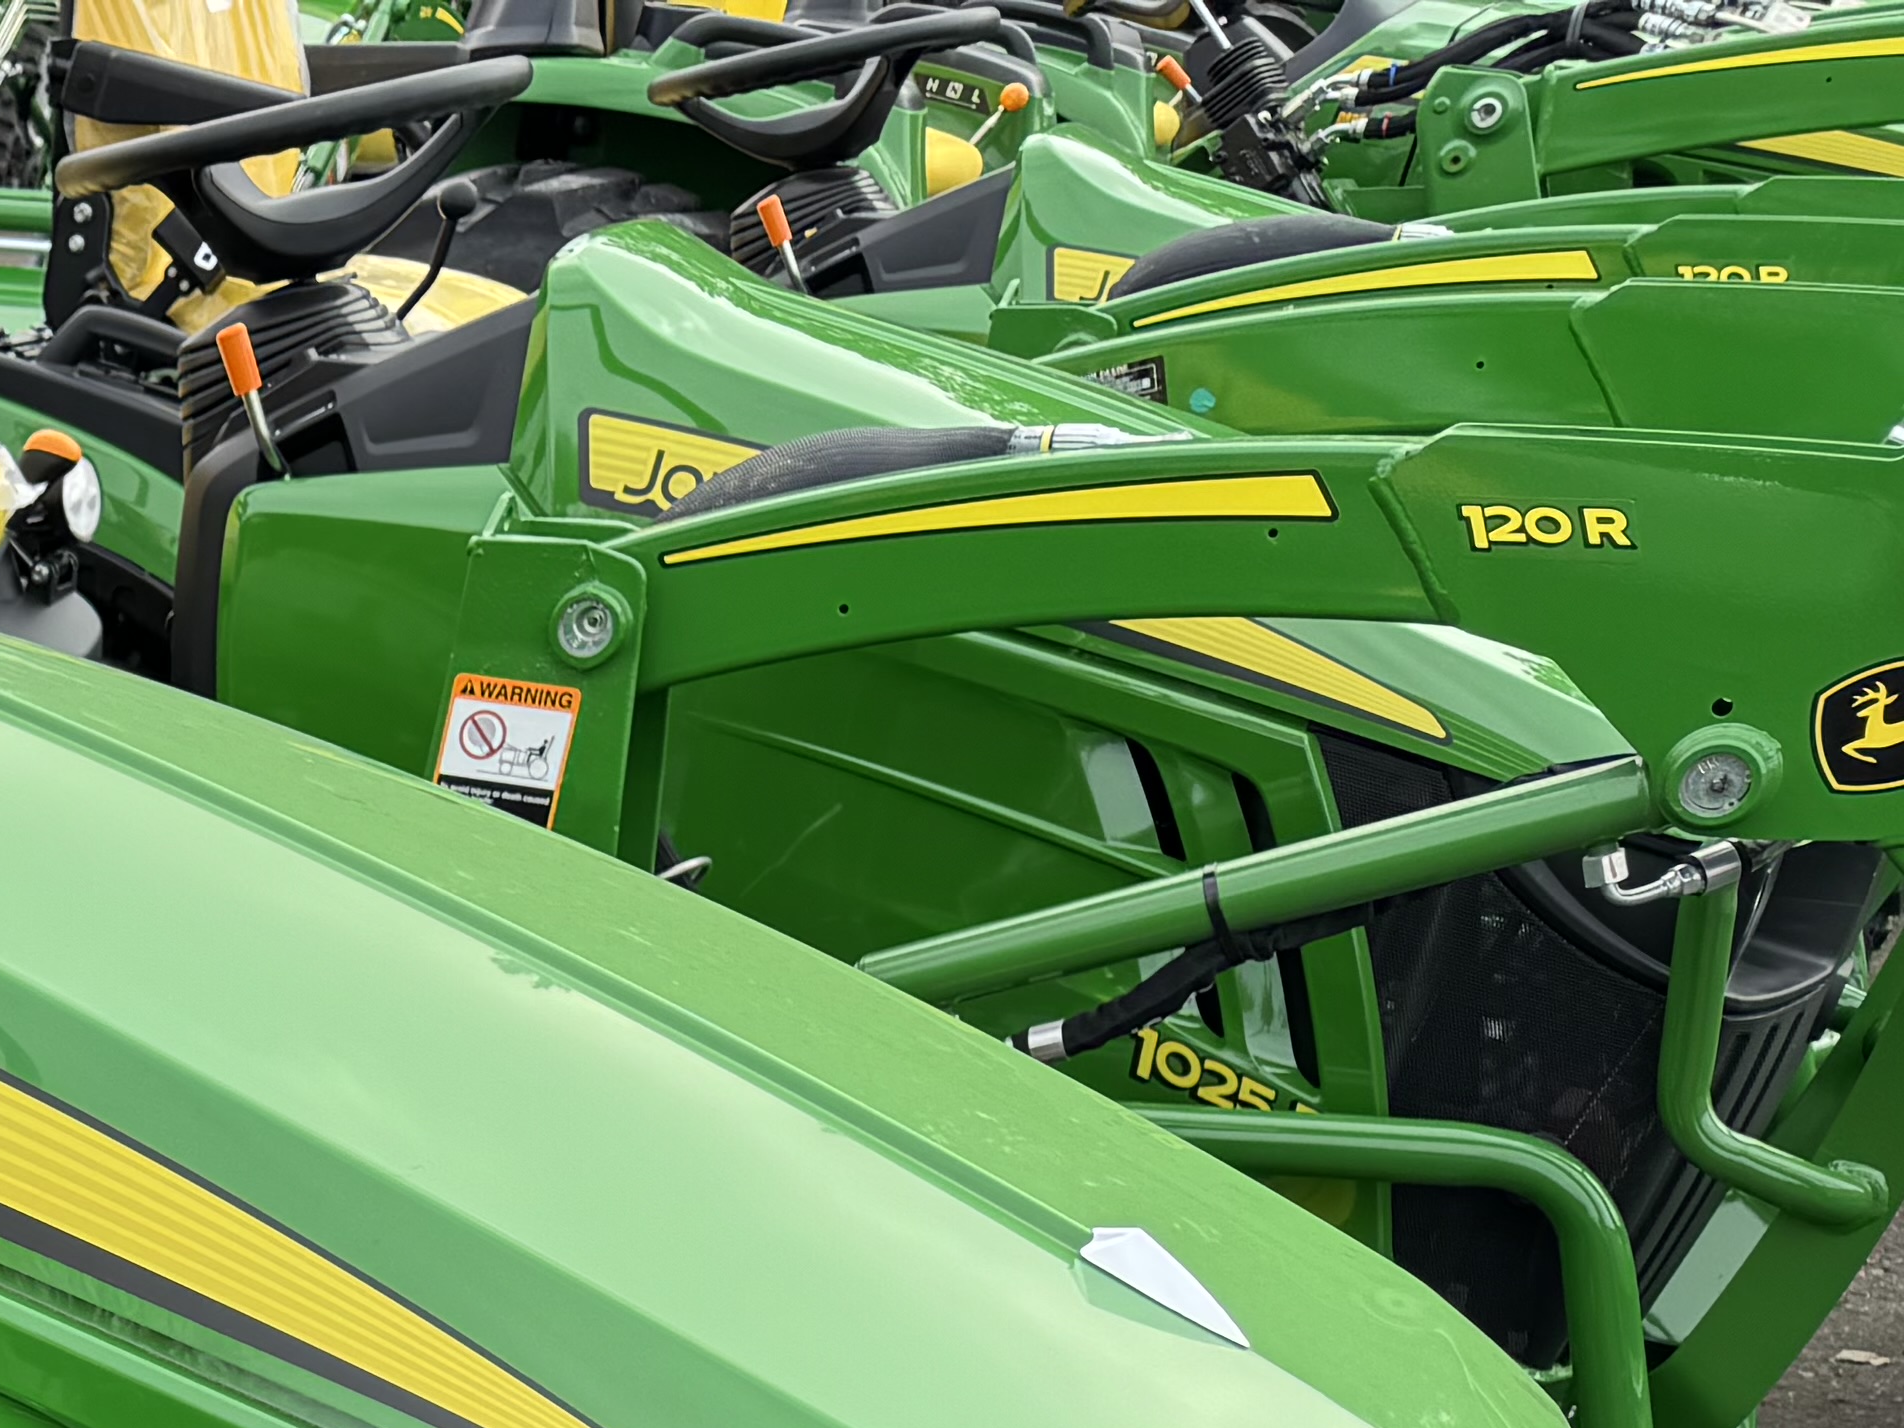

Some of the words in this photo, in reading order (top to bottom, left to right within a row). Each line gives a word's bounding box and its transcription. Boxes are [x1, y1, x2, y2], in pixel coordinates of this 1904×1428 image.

[1457, 503, 1573, 552] 120
[1578, 506, 1638, 549] R
[479, 680, 573, 709] WARNING
[1131, 1028, 1276, 1112] 1025
